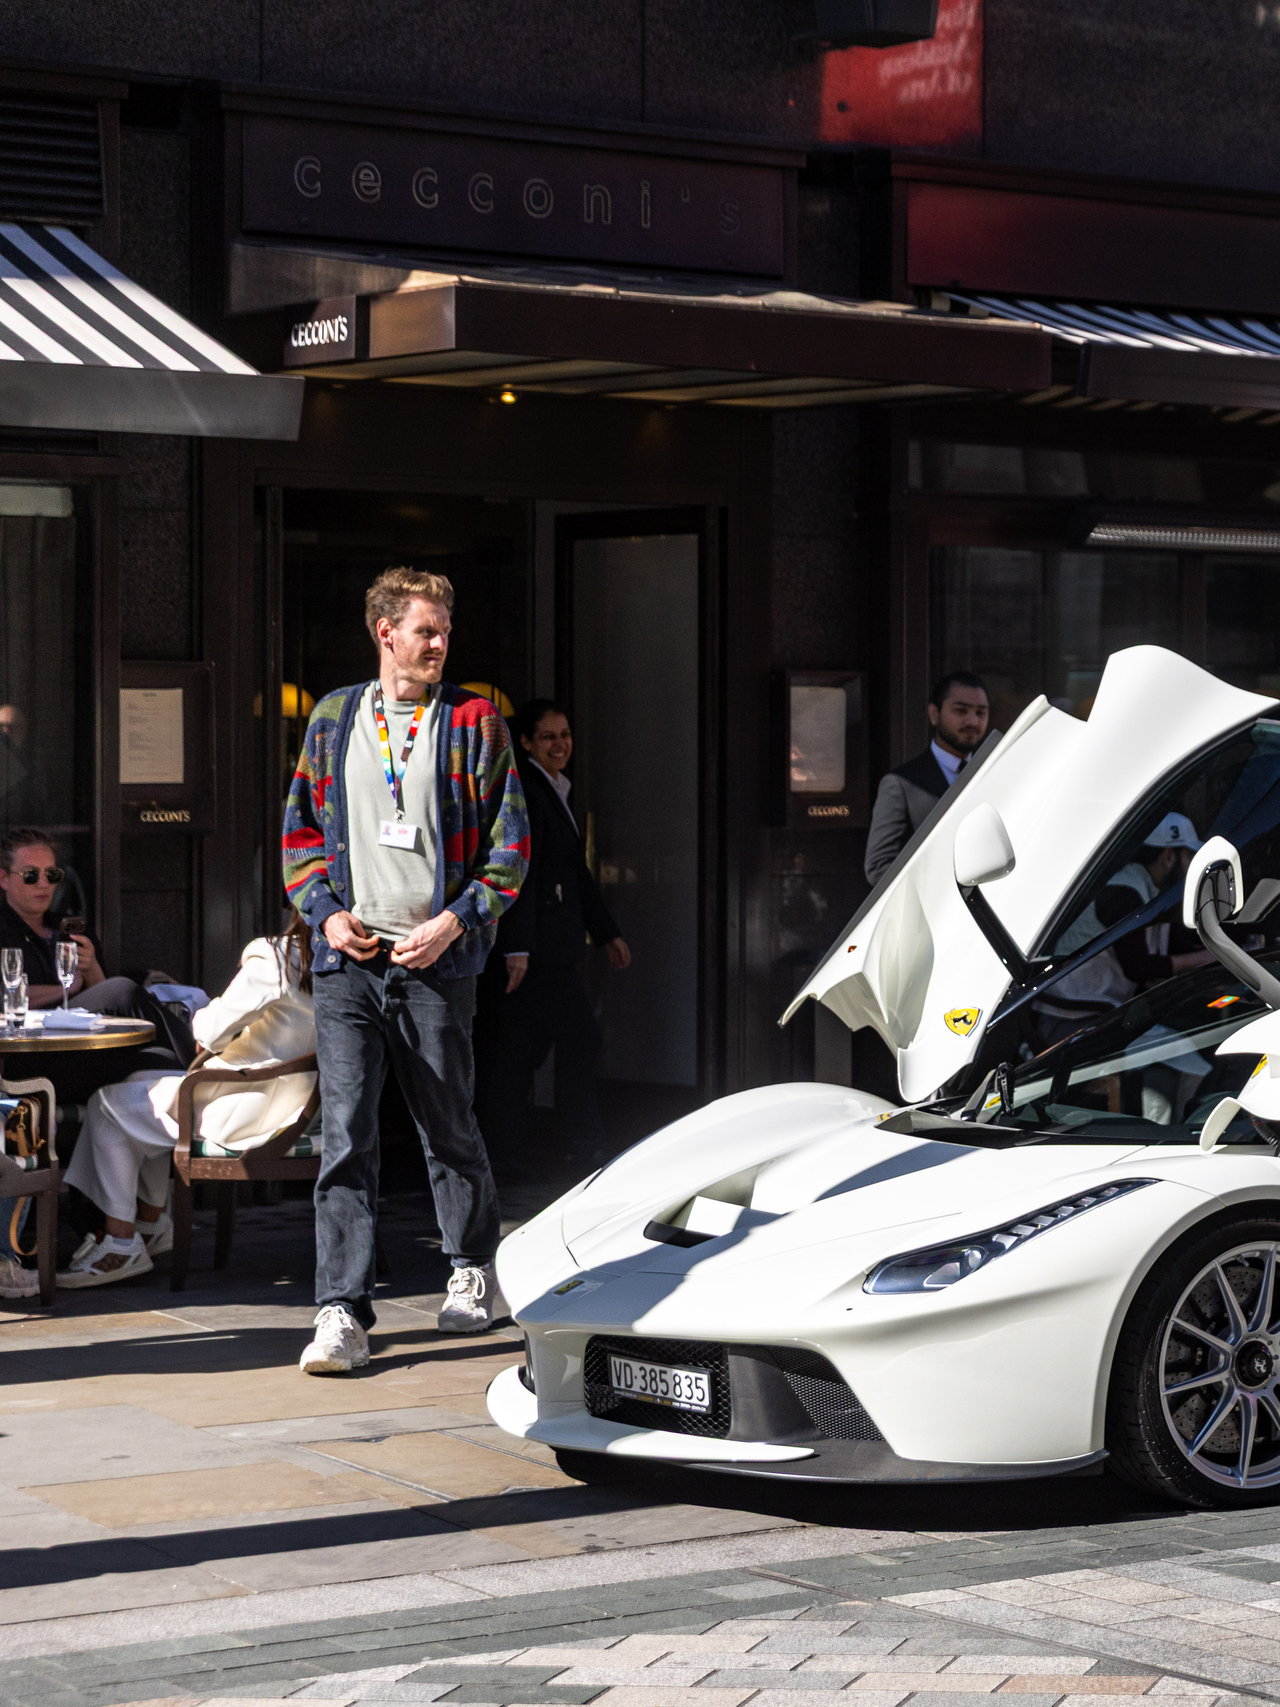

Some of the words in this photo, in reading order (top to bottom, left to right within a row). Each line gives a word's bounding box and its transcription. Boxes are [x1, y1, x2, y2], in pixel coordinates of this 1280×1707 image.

[294, 155, 741, 235] cecconi's
[291, 314, 348, 348] CECCONI'S
[1170, 825, 1180, 839] 3
